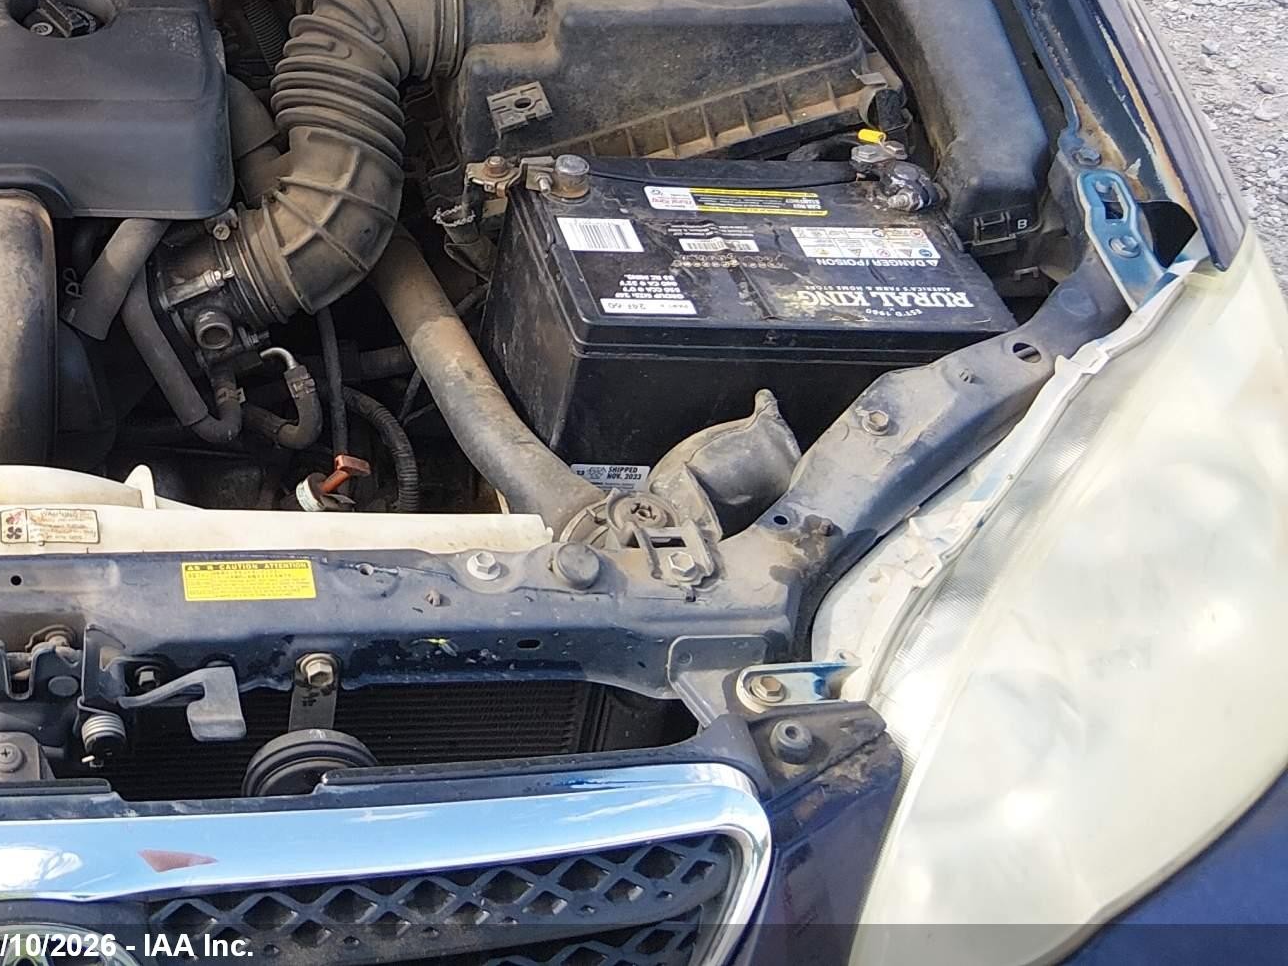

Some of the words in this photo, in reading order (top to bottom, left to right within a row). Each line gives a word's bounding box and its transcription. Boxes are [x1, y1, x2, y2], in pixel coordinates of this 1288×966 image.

[1017, 219, 1028, 230] B
[816, 258, 864, 266] POISON
[872, 259, 926, 267] DANGER
[797, 291, 870, 307] KING
[869, 291, 974, 308] RURAL
